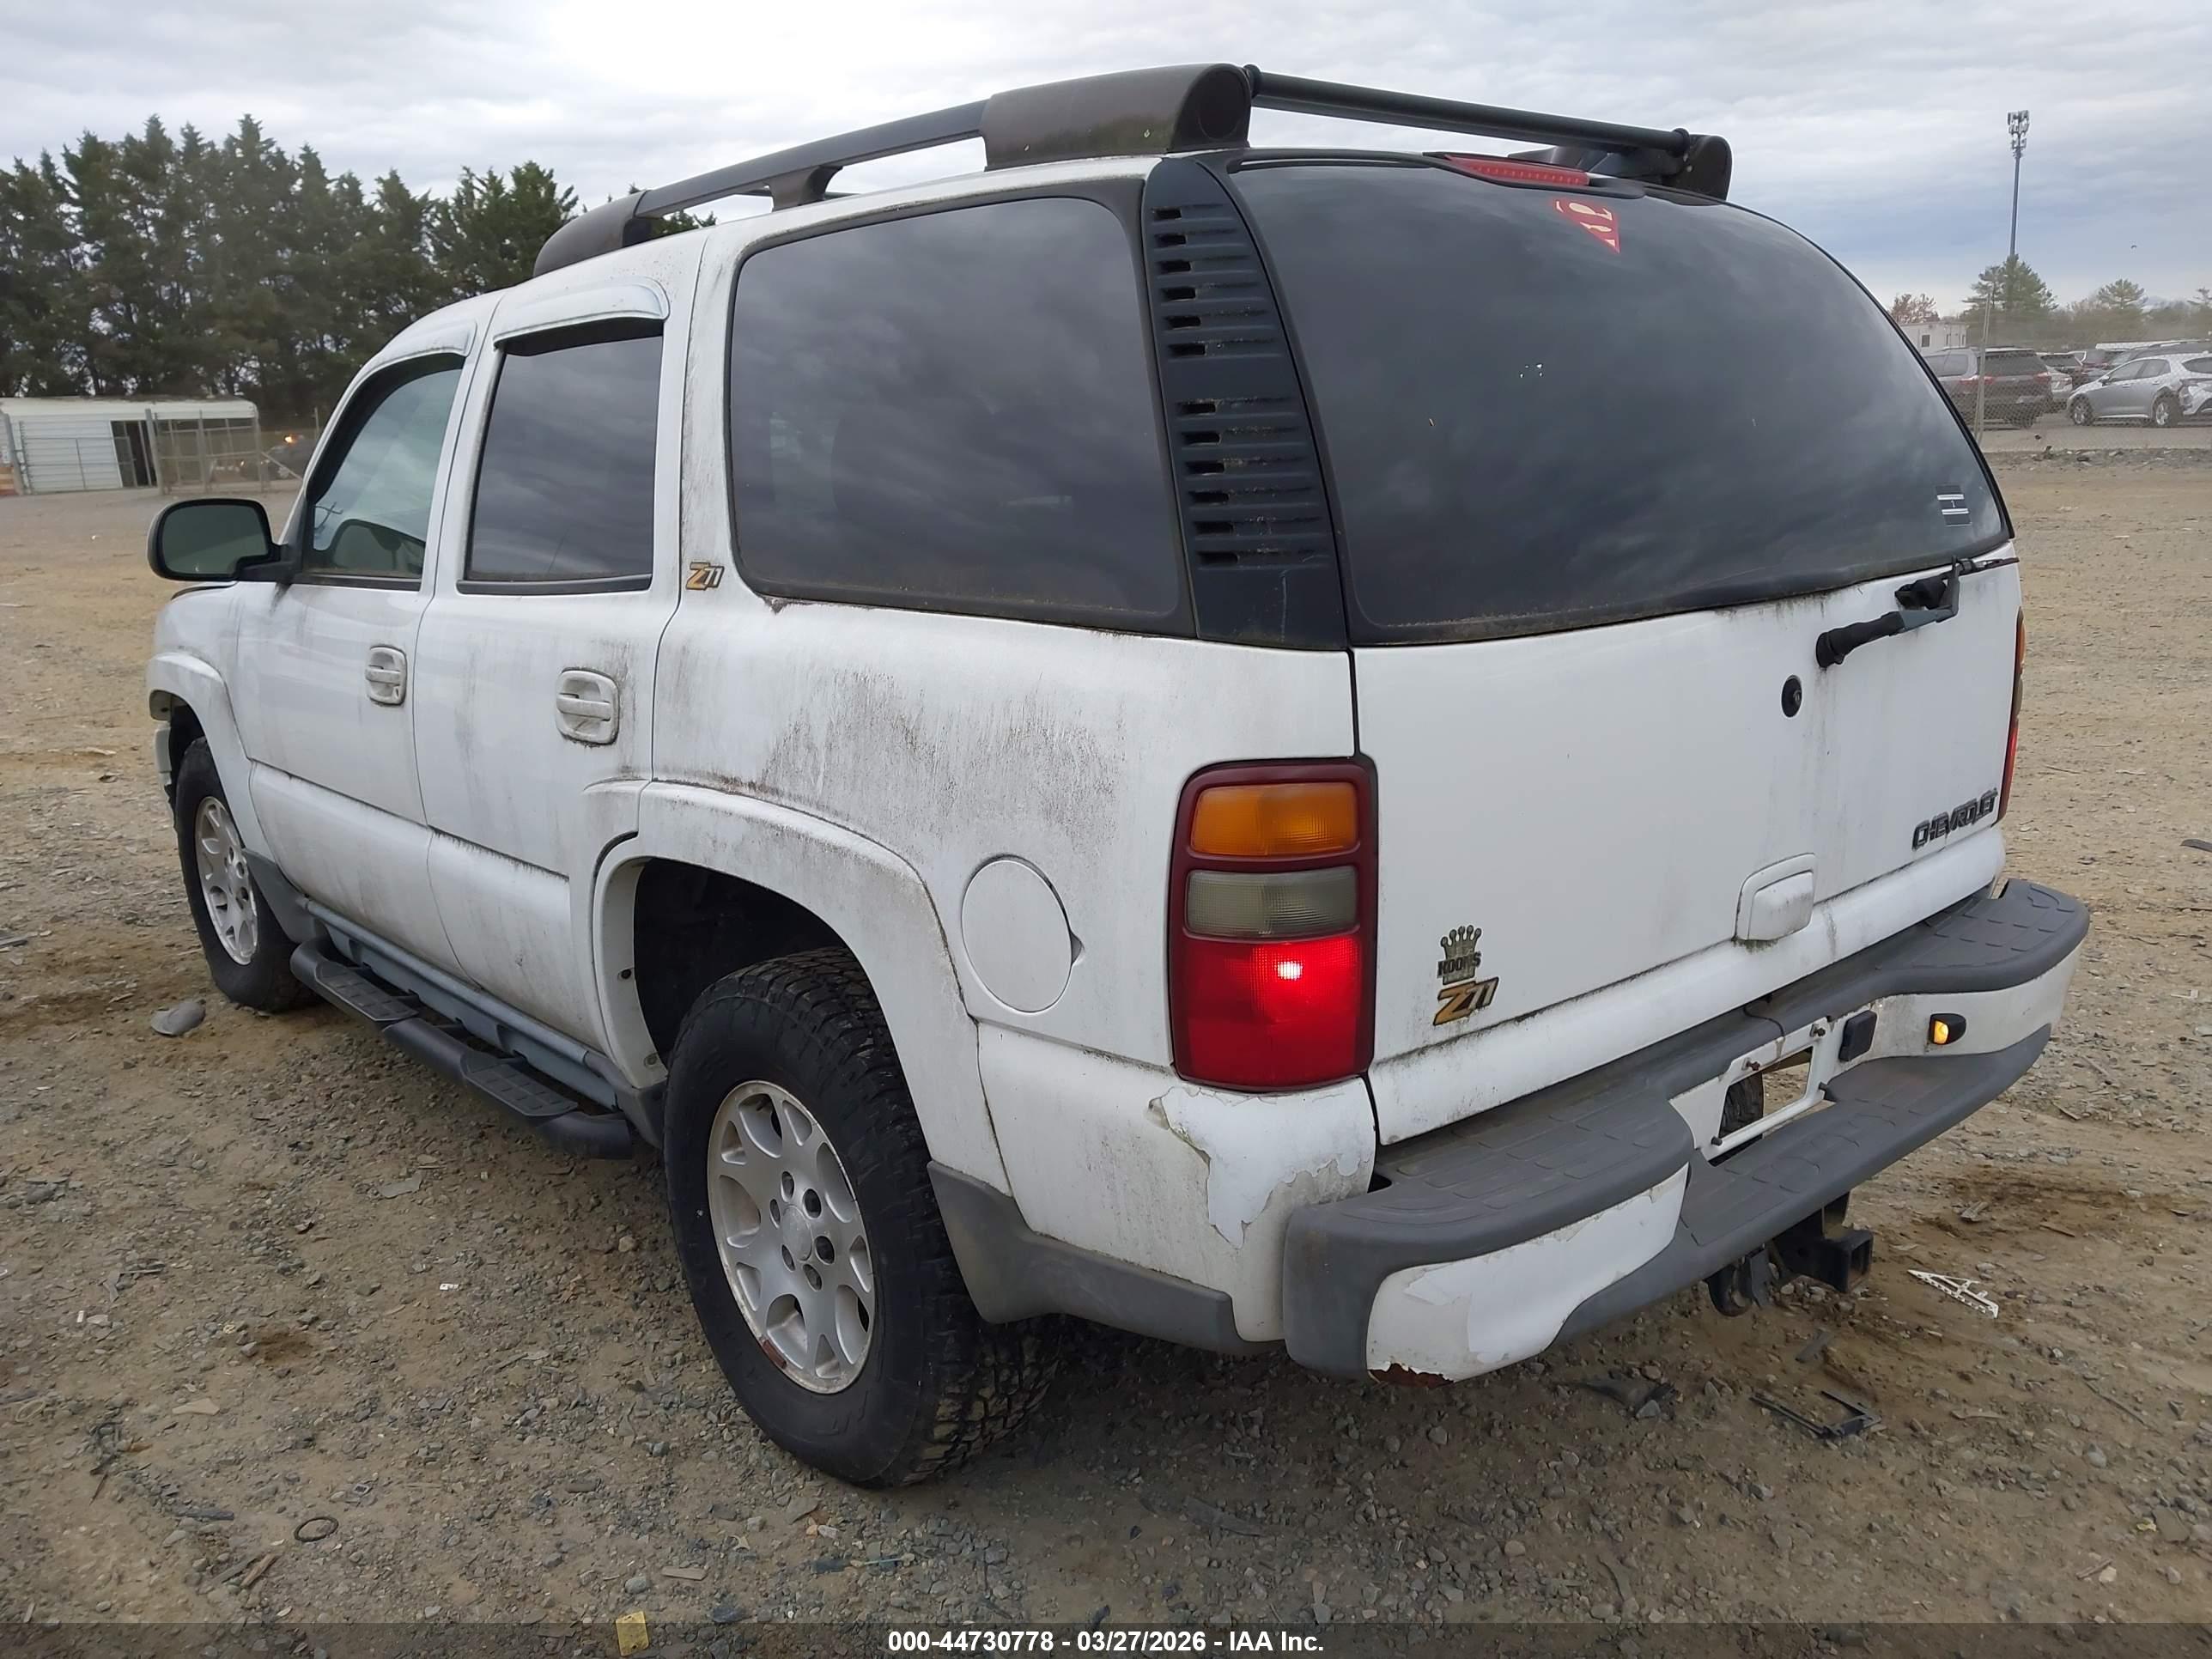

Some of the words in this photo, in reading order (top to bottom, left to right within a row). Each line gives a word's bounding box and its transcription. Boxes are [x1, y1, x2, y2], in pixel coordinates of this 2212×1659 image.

[685, 561, 726, 592] Z71
[1911, 787, 1997, 850] CHEVROLET
[1433, 976, 1498, 1026] Z71
